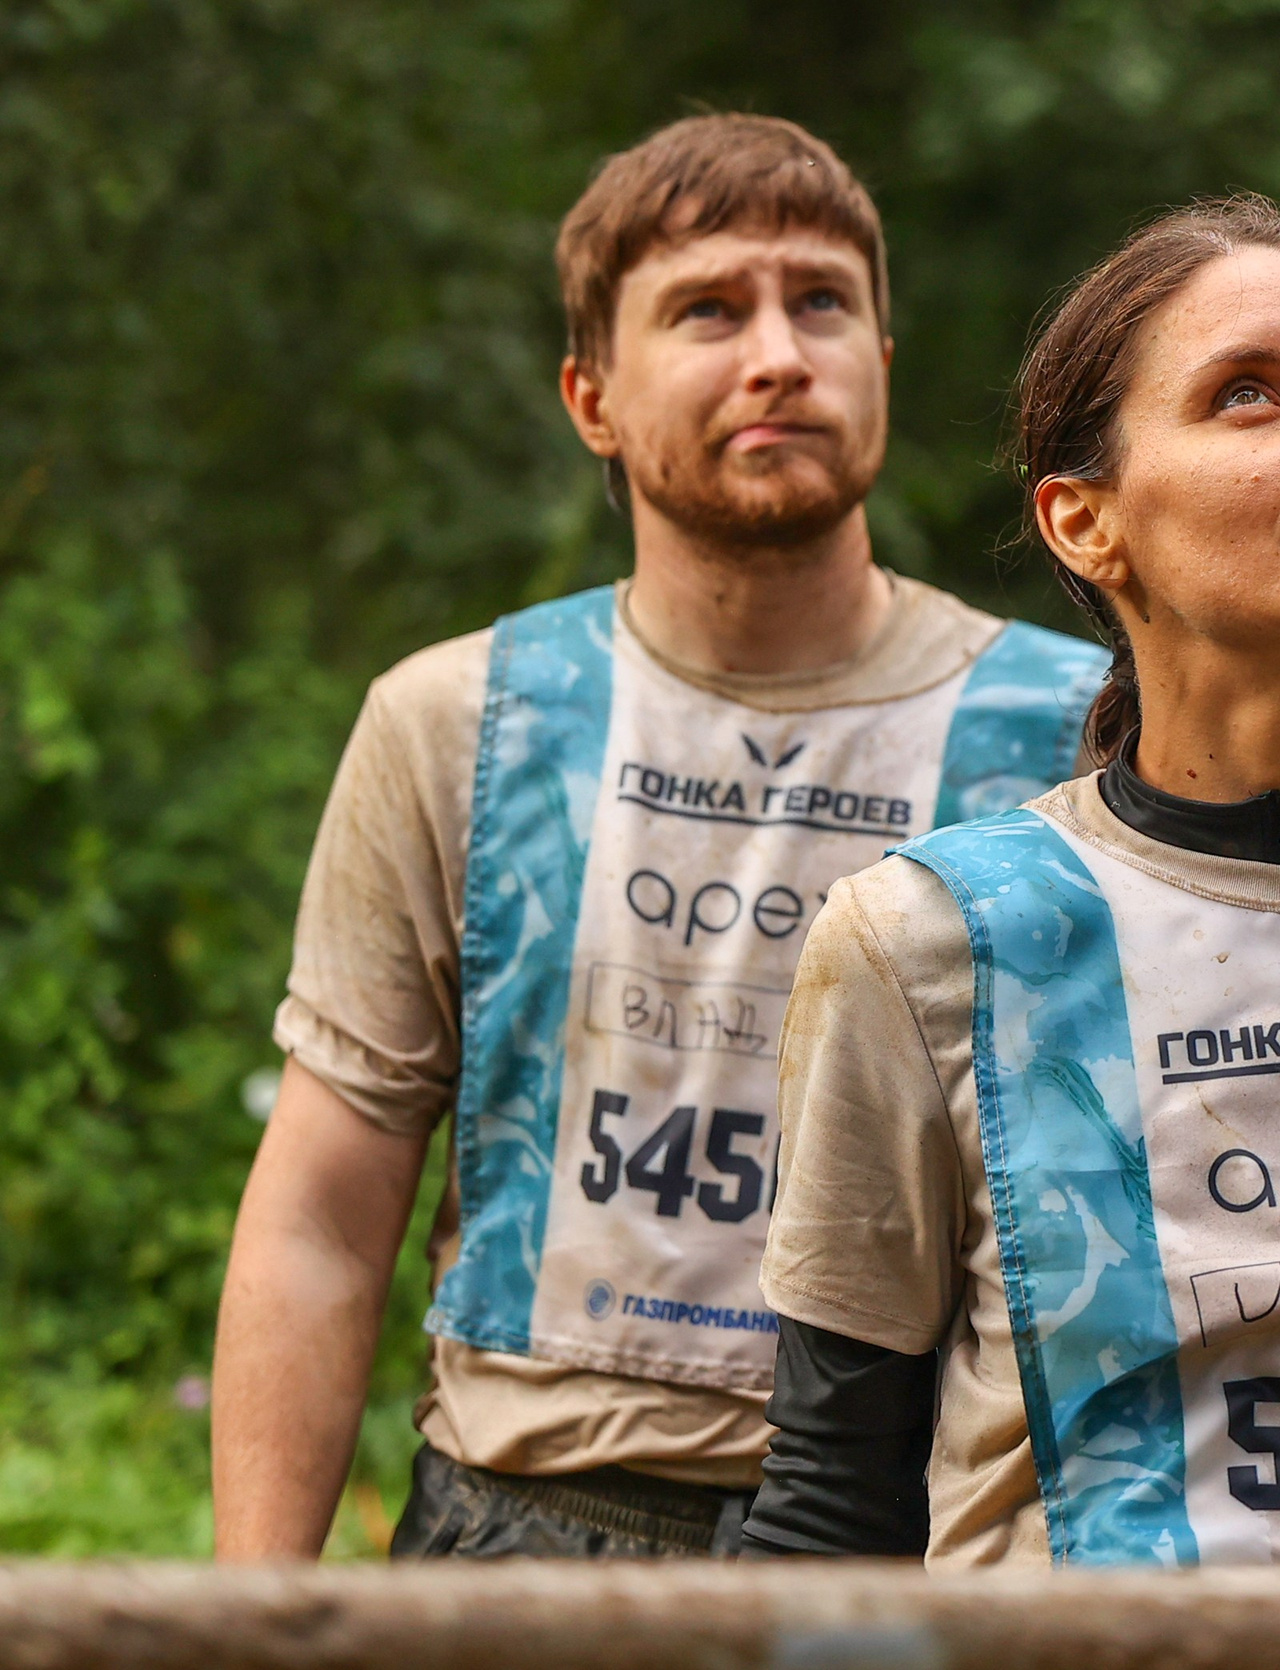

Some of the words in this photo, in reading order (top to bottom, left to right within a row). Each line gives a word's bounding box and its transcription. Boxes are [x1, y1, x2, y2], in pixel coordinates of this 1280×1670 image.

[619, 763, 747, 811] ГОНКА
[761, 785, 911, 826] ГЕРОЕВ
[626, 868, 829, 946] ape
[581, 1088, 782, 1223] 545
[622, 1295, 780, 1333] ГАЗПРОМБАНК
